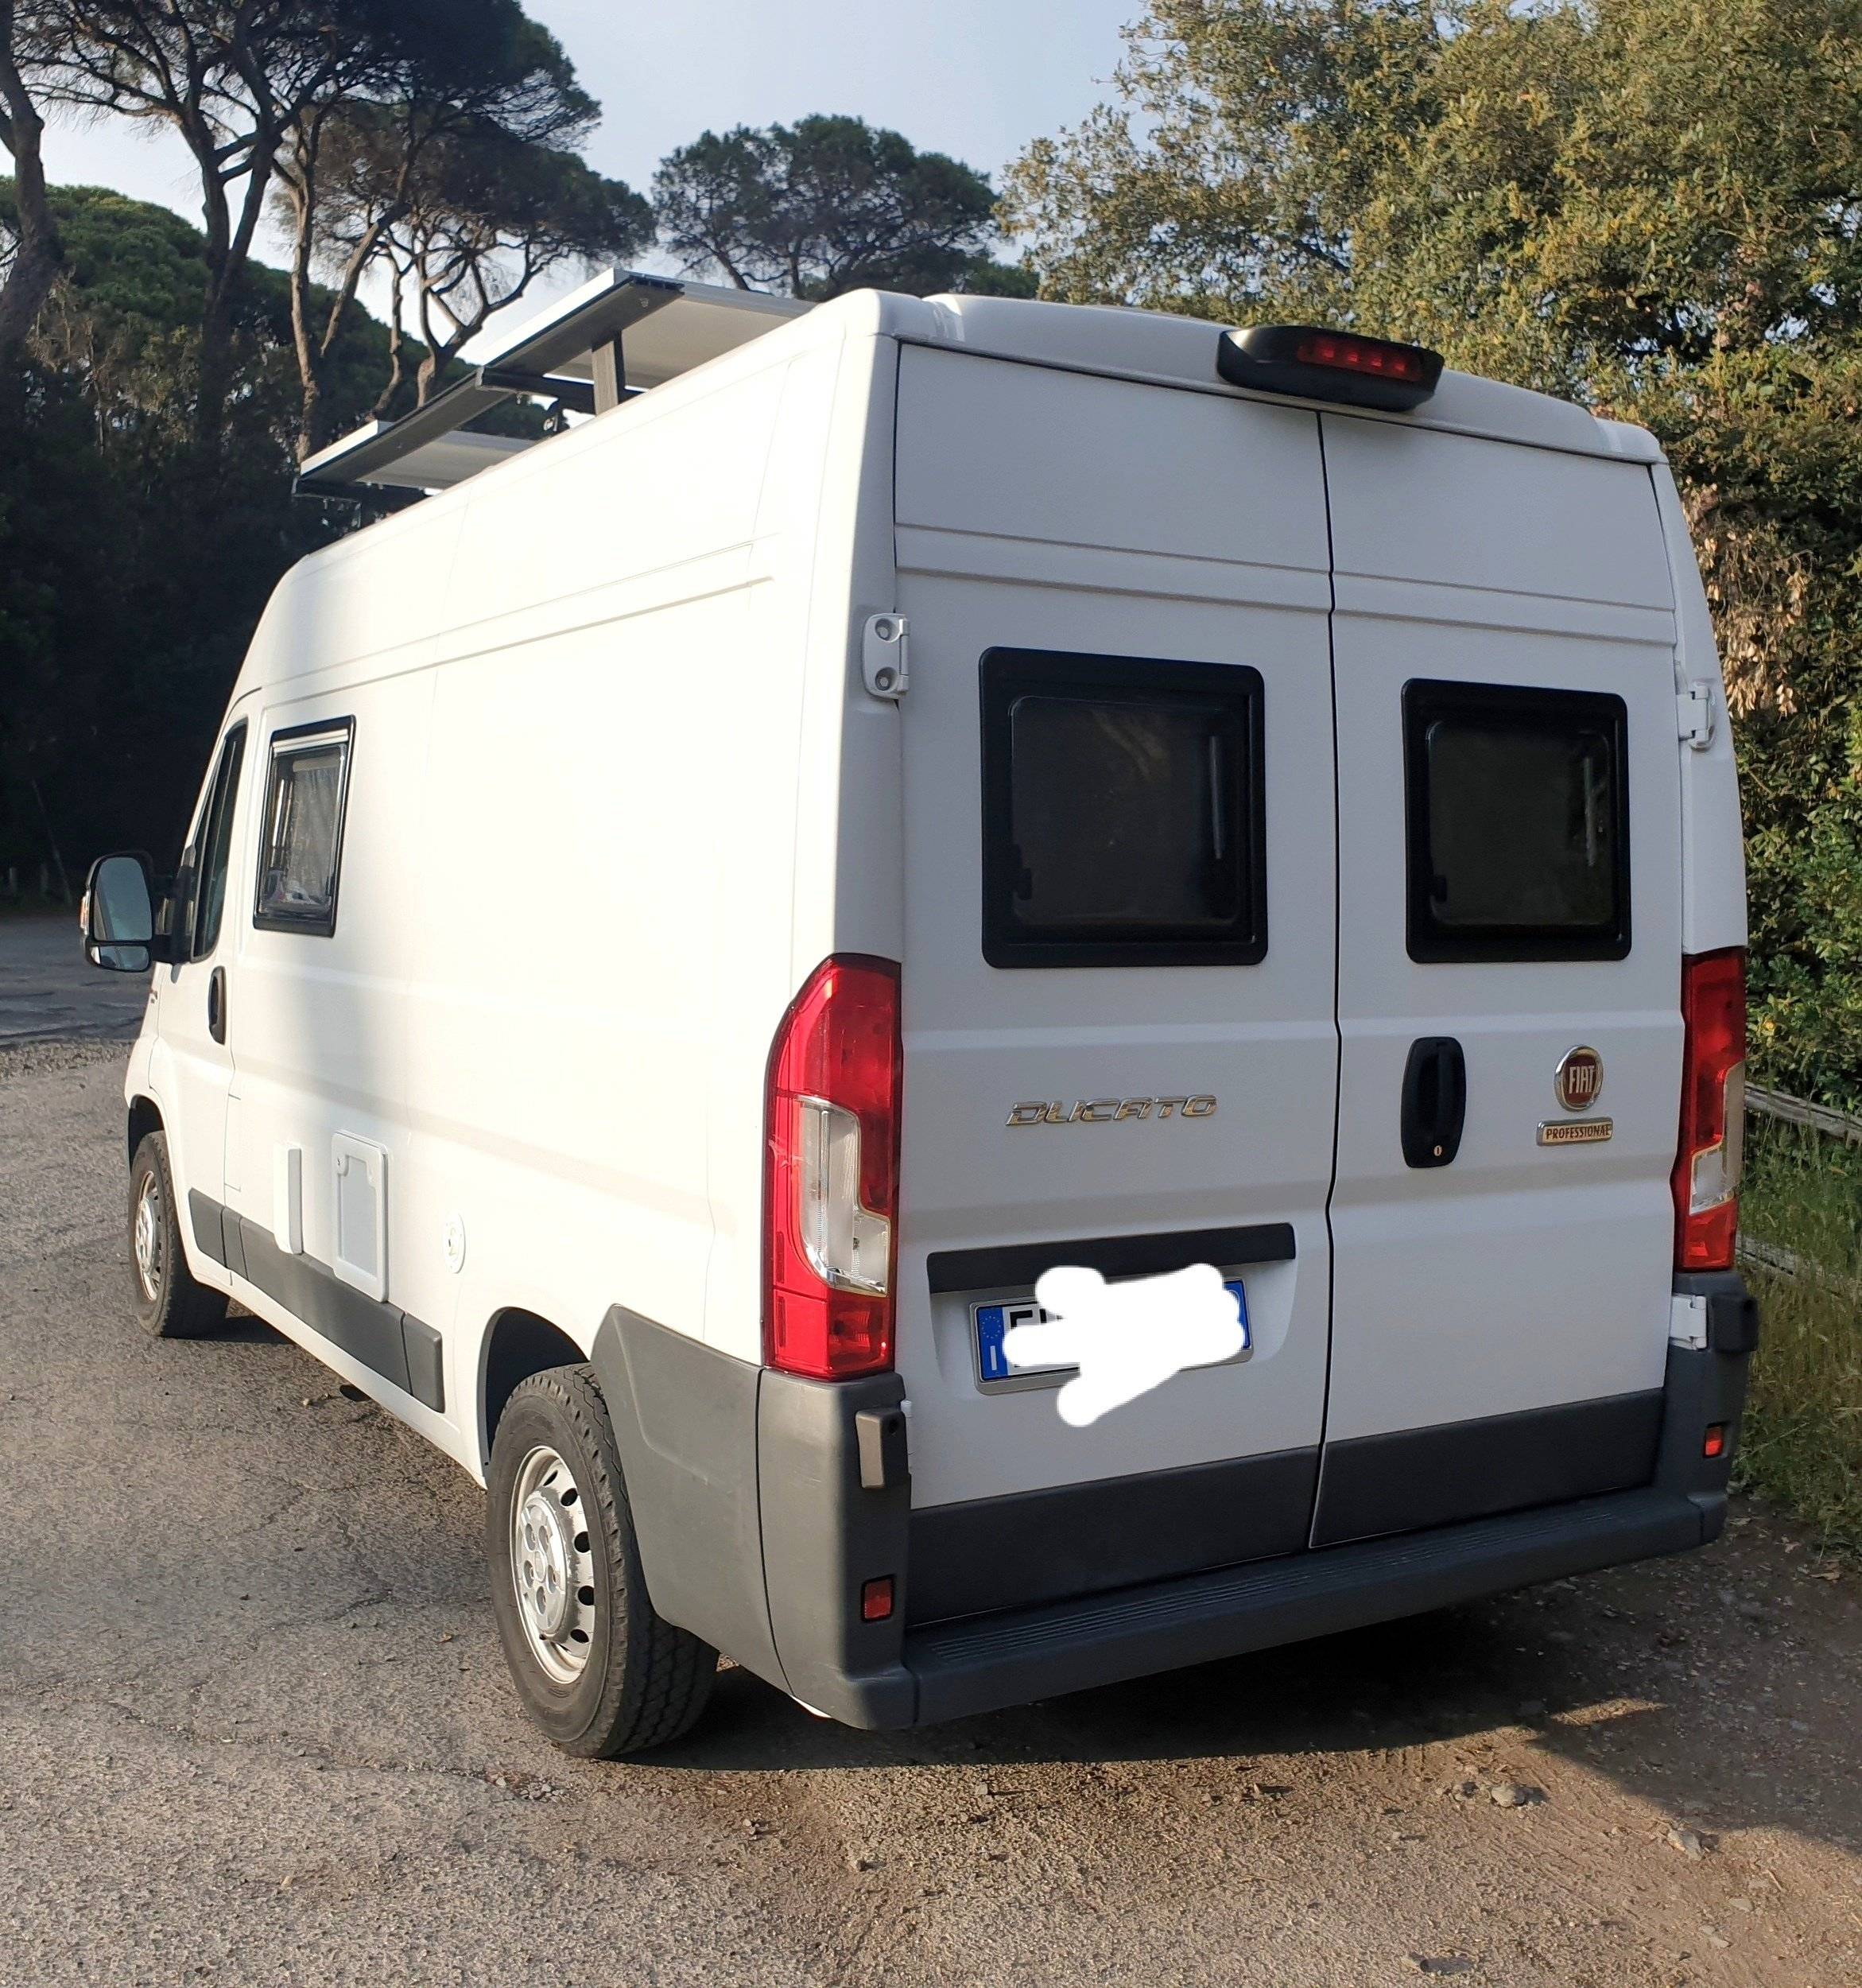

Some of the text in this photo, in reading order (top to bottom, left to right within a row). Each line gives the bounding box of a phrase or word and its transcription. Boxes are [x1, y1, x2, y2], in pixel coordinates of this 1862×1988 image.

[1569, 1066, 1595, 1093] FIAT
[1005, 1094, 1216, 1126] DUCATO
[1546, 1124, 1610, 1140] PROFESSIONAL
